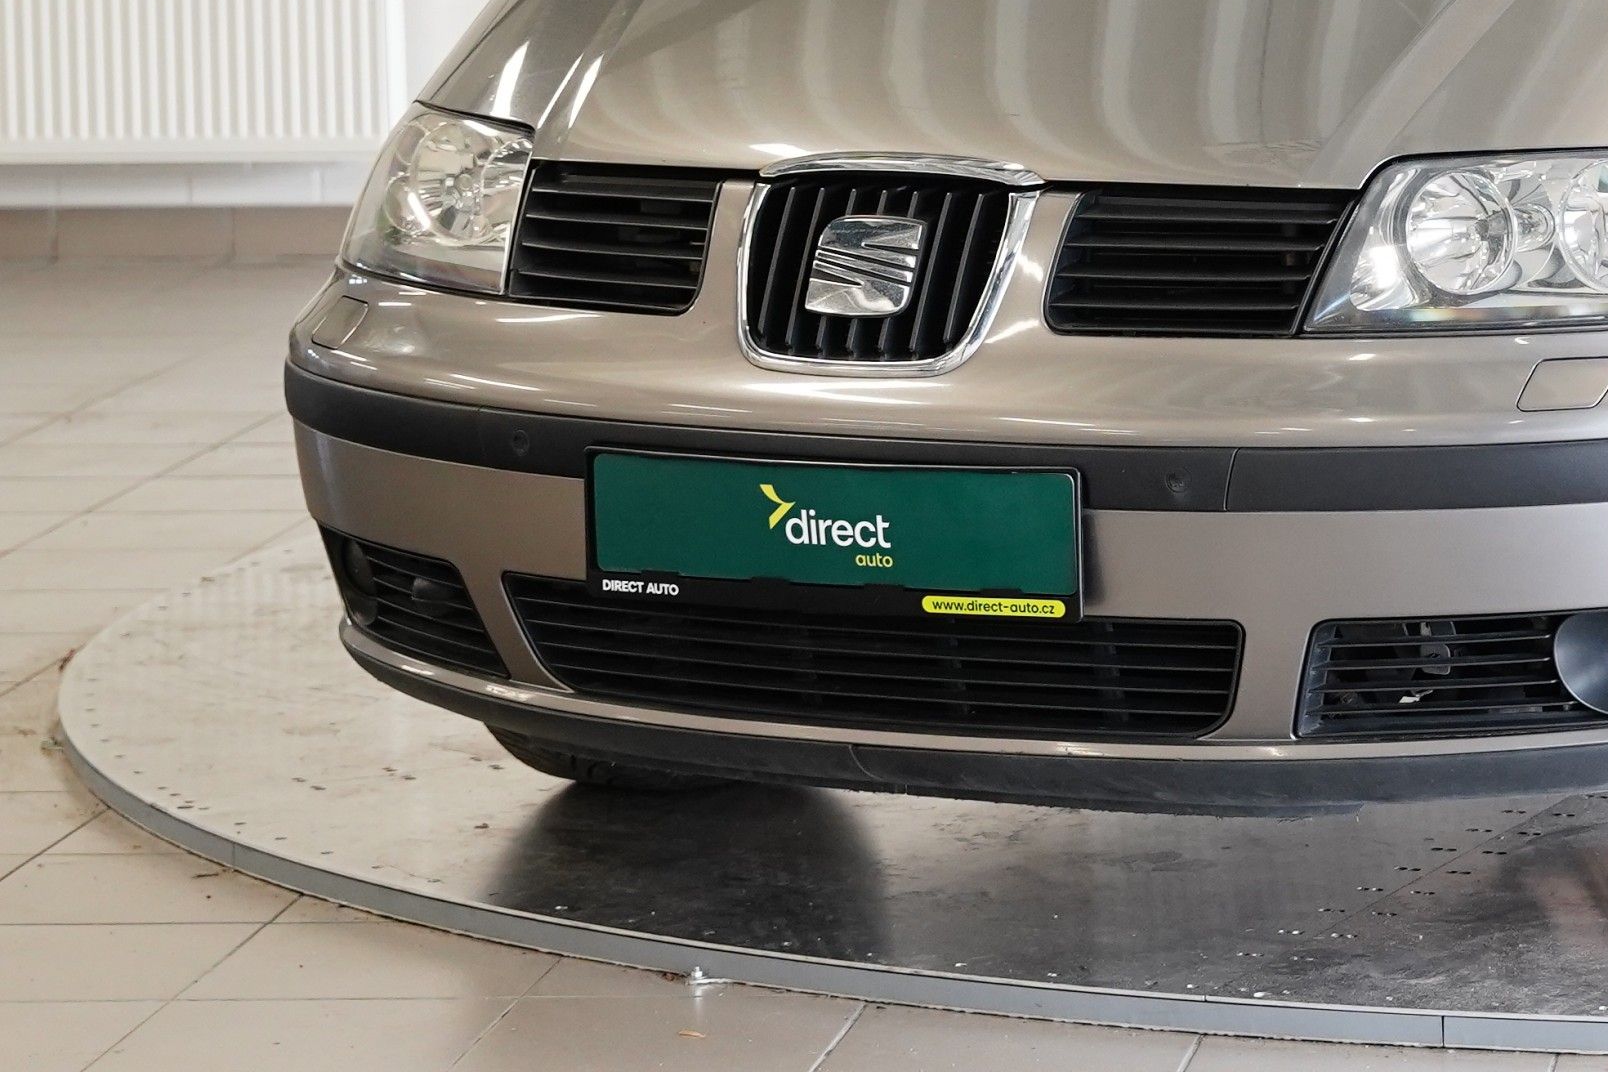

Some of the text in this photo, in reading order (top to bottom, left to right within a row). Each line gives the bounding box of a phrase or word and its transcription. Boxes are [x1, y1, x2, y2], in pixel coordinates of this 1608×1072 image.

[785, 509, 892, 548] direct
[855, 553, 893, 568] auto
[602, 579, 679, 596] DIRECT AUTO
[931, 600, 1055, 614] www.direct-auto.cz
